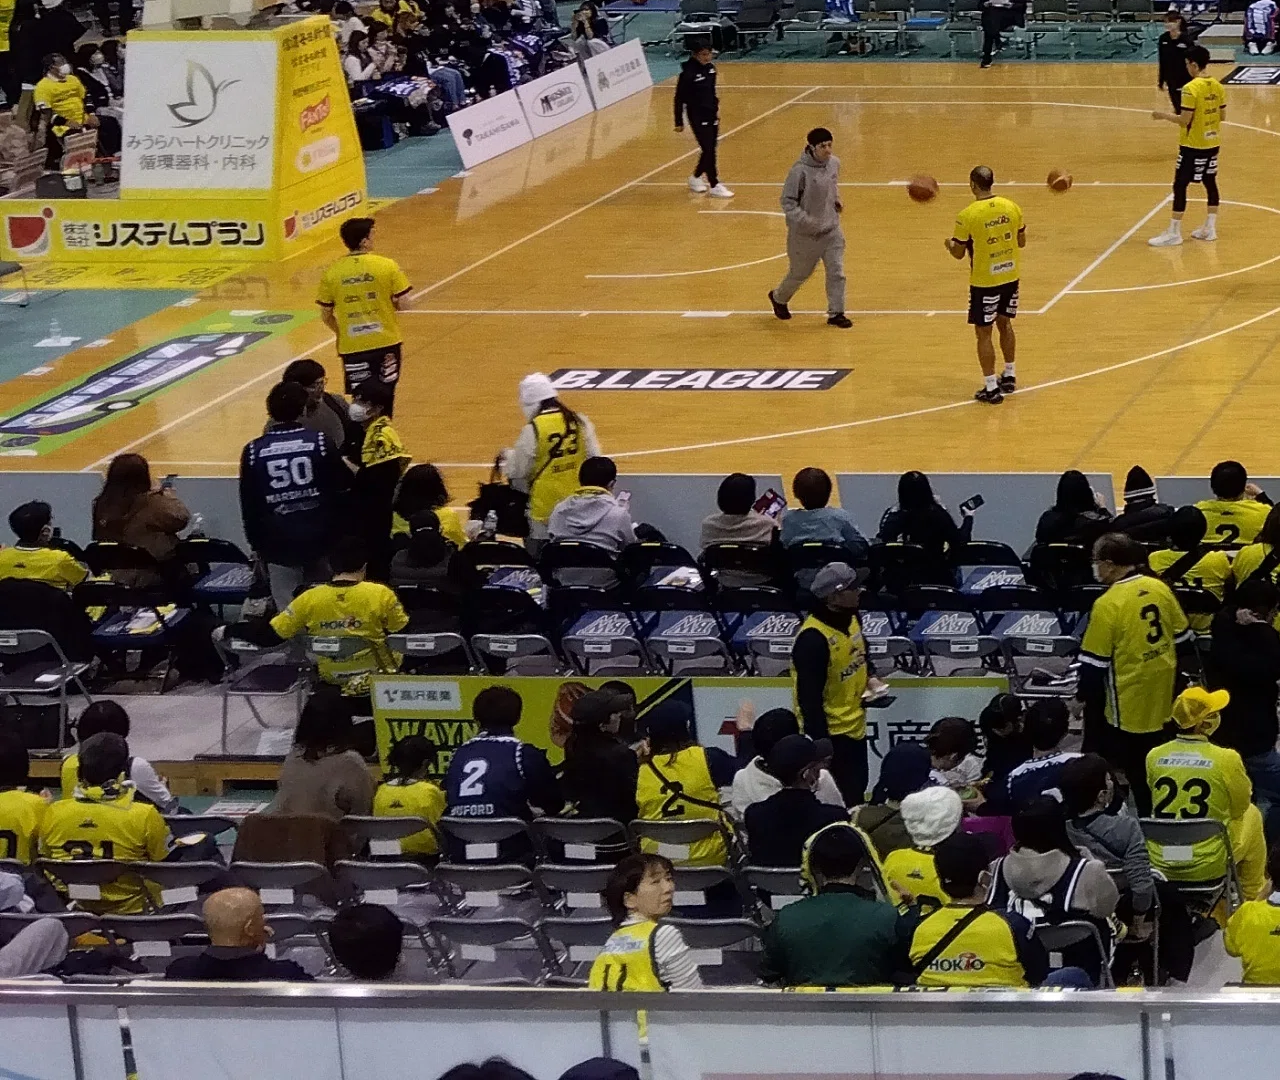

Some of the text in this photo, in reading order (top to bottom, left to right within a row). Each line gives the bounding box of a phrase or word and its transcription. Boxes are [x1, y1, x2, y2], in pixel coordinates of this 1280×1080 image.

[126, 134, 271, 150] みうらハートクリニック
[138, 153, 257, 171] 循環器科・内科
[309, 189, 363, 226] システムプラン
[93, 221, 265, 246] システムプラン
[552, 369, 839, 390] B.LEAGUE
[548, 432, 578, 459] 23
[266, 456, 314, 489] 50
[265, 487, 321, 504] MARSHALL
[319, 617, 362, 630] HOKTO
[1140, 604, 1163, 645] 3
[459, 759, 488, 798] 2
[1154, 776, 1211, 820] 23
[928, 952, 984, 973] HOKTO
